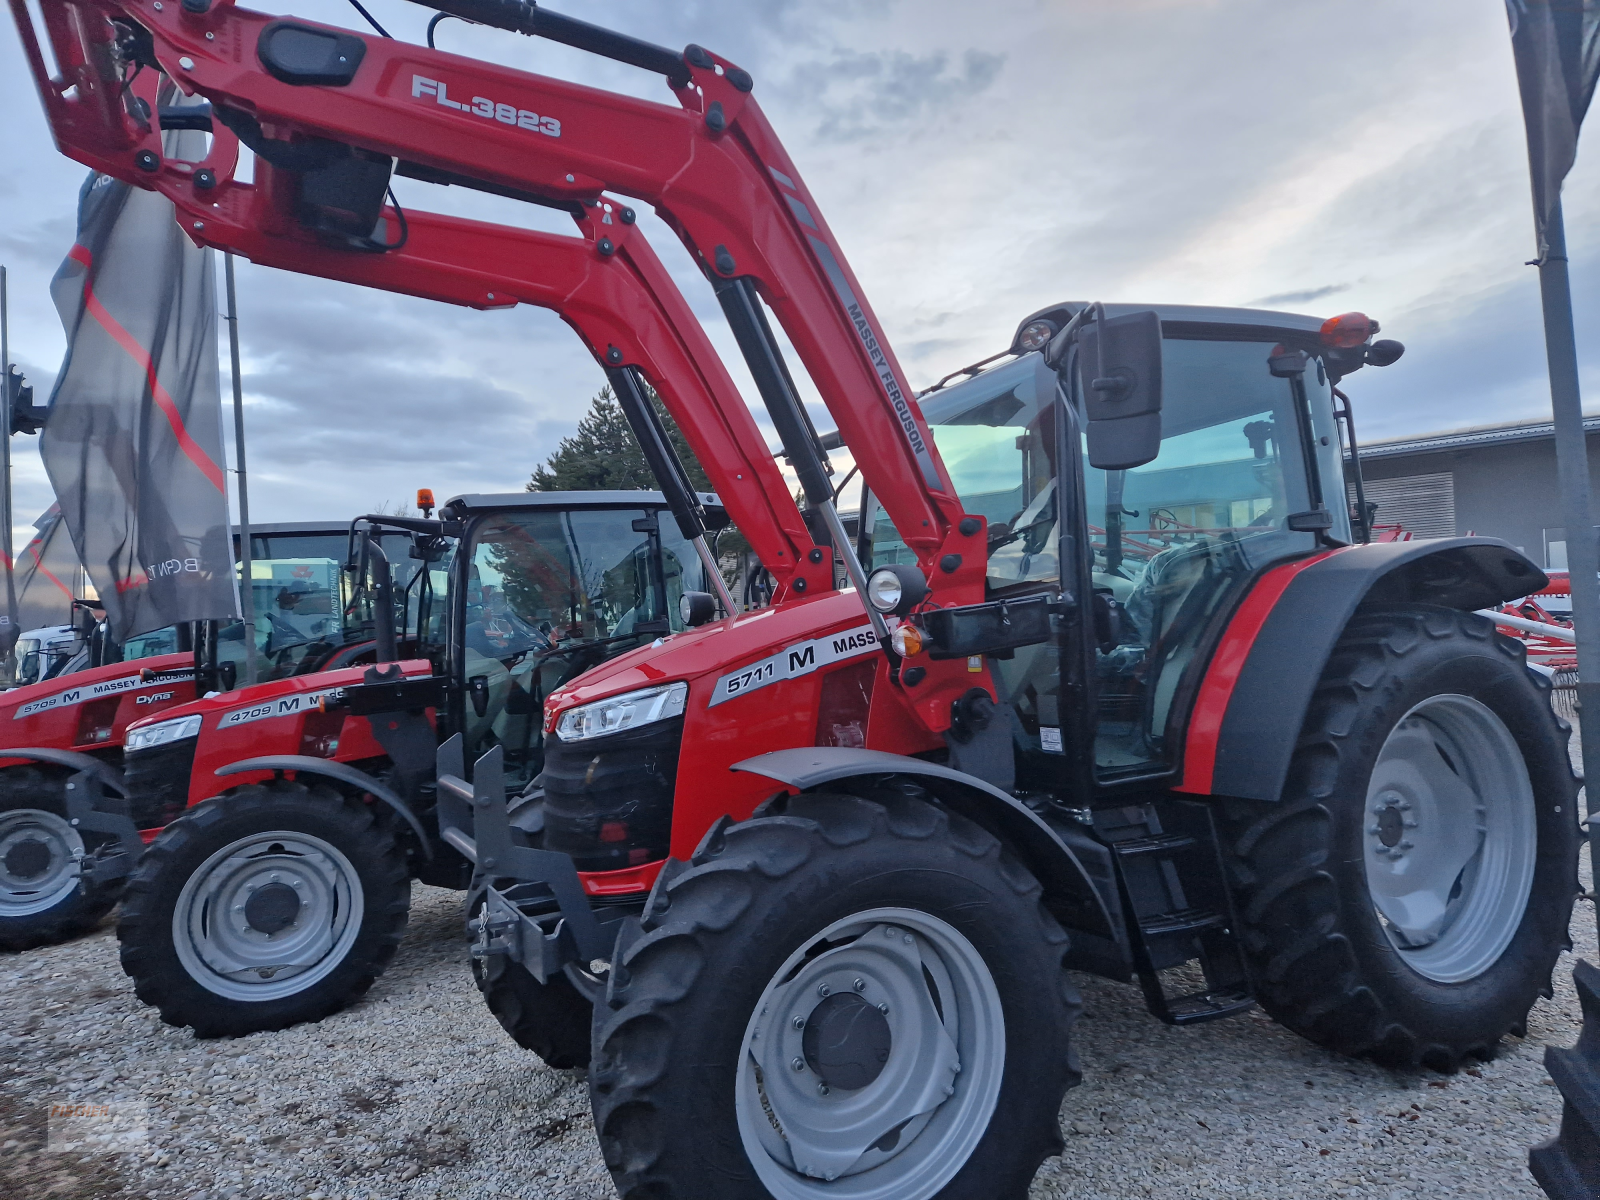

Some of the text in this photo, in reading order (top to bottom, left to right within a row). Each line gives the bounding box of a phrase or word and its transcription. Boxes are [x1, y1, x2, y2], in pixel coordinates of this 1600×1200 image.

[412, 74, 561, 138] FL.3823
[847, 303, 925, 455] MASSEY FERGUSON
[727, 663, 774, 694] 5711
[788, 646, 815, 672] M
[24, 698, 57, 713] 5709
[62, 690, 80, 703] M
[93, 679, 136, 694] MASSEY
[136, 692, 172, 704] Dyna
[230, 706, 272, 722] 4709
[278, 697, 300, 713] M
